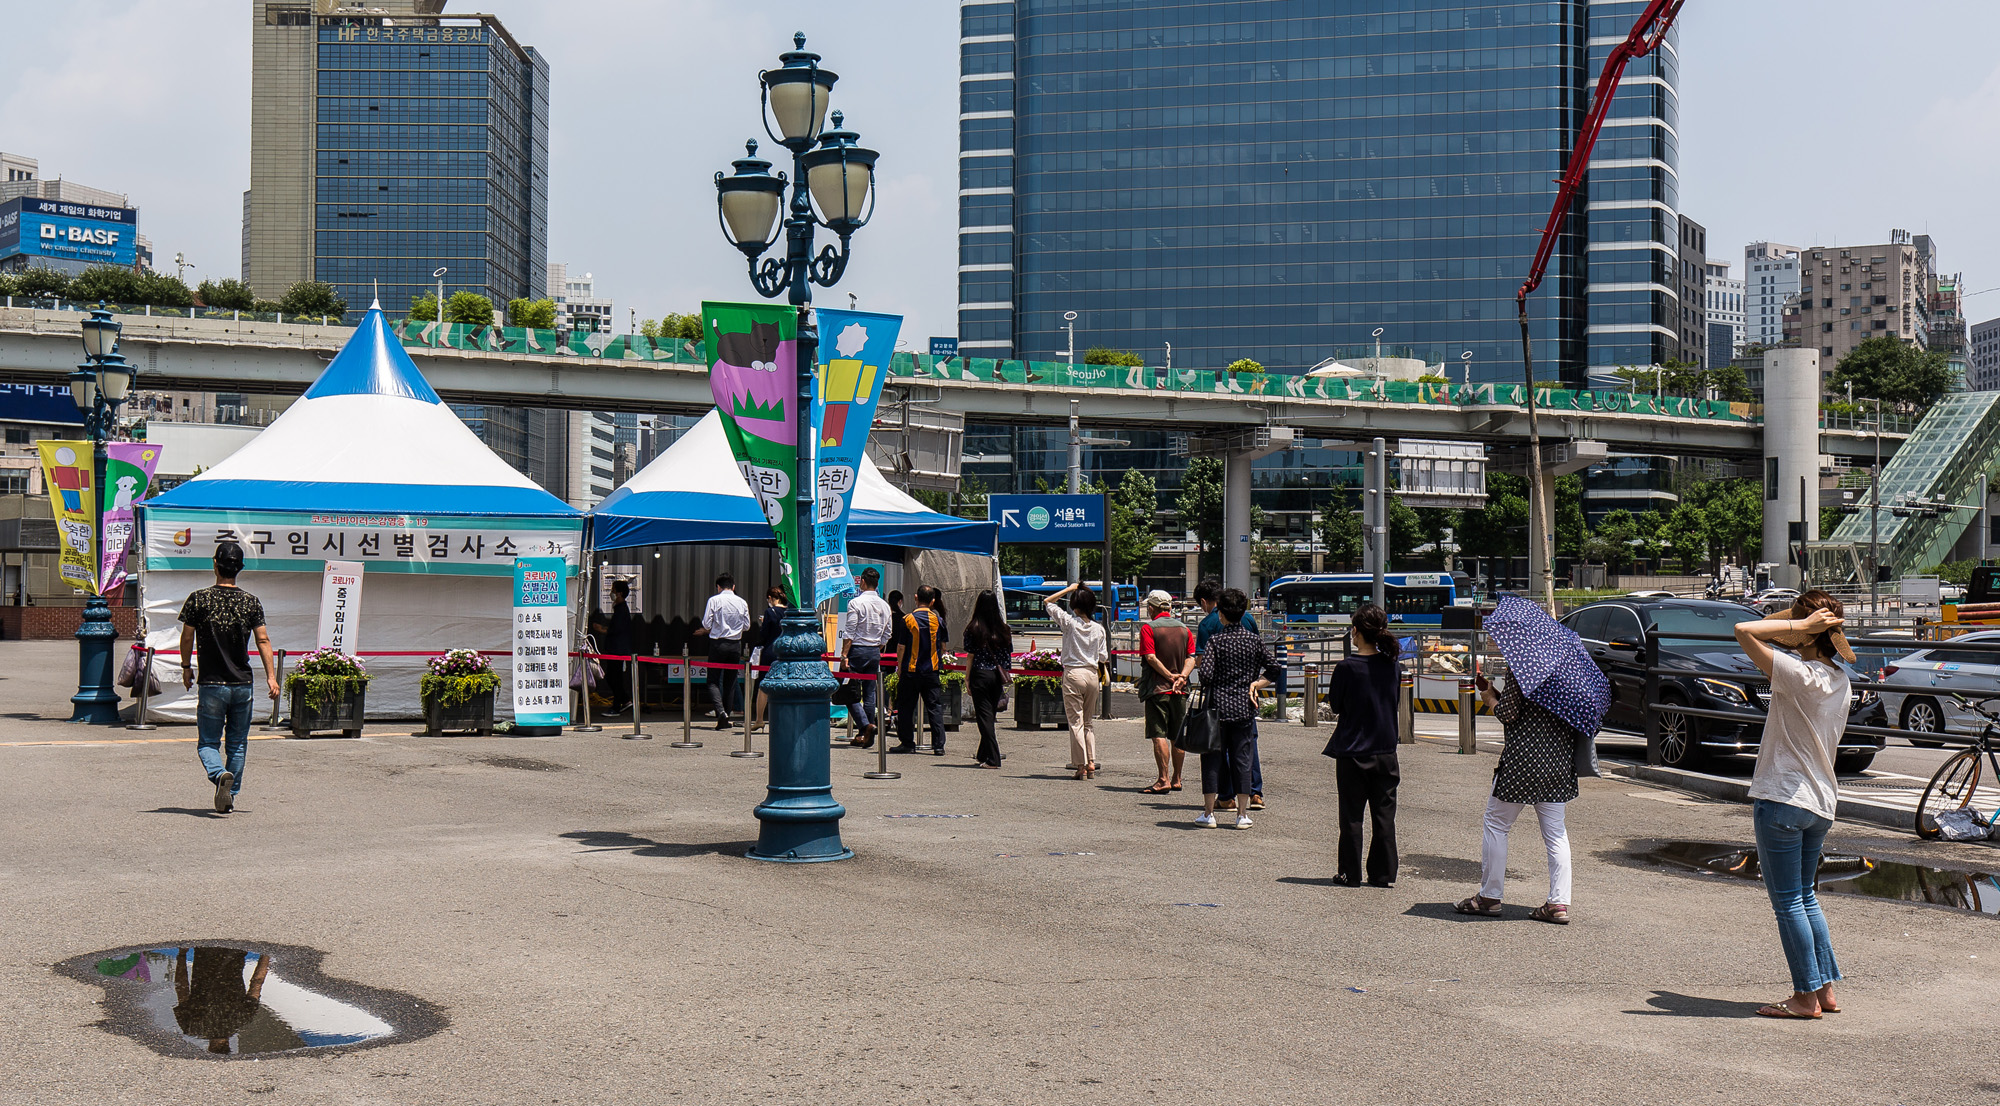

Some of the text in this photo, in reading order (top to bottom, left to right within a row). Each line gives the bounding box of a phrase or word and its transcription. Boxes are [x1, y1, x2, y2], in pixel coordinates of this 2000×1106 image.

[338, 27, 482, 42] HF 한국주택금융공사
[39, 202, 121, 221] 세계 제일의 화학기업
[68, 225, 119, 245] BASF
[40, 242, 117, 258] We create chemistry
[1030, 513, 1048, 522] 경의선
[1054, 508, 1085, 521] 서울역
[311, 515, 406, 527] 코로나바이러스감염증
[416, 518, 428, 526] 19
[331, 575, 355, 585] 코로나19
[524, 572, 557, 580] 코로나19
[522, 582, 559, 592] 선별검사
[522, 594, 559, 604] 순서안내
[525, 613, 531, 623] 손
[532, 613, 542, 623] 소독
[525, 629, 551, 639] 역학조사서
[525, 696, 531, 706] 손
[532, 695, 543, 705] 소독
[544, 695, 550, 705] 후
[551, 695, 563, 705] 귀가
